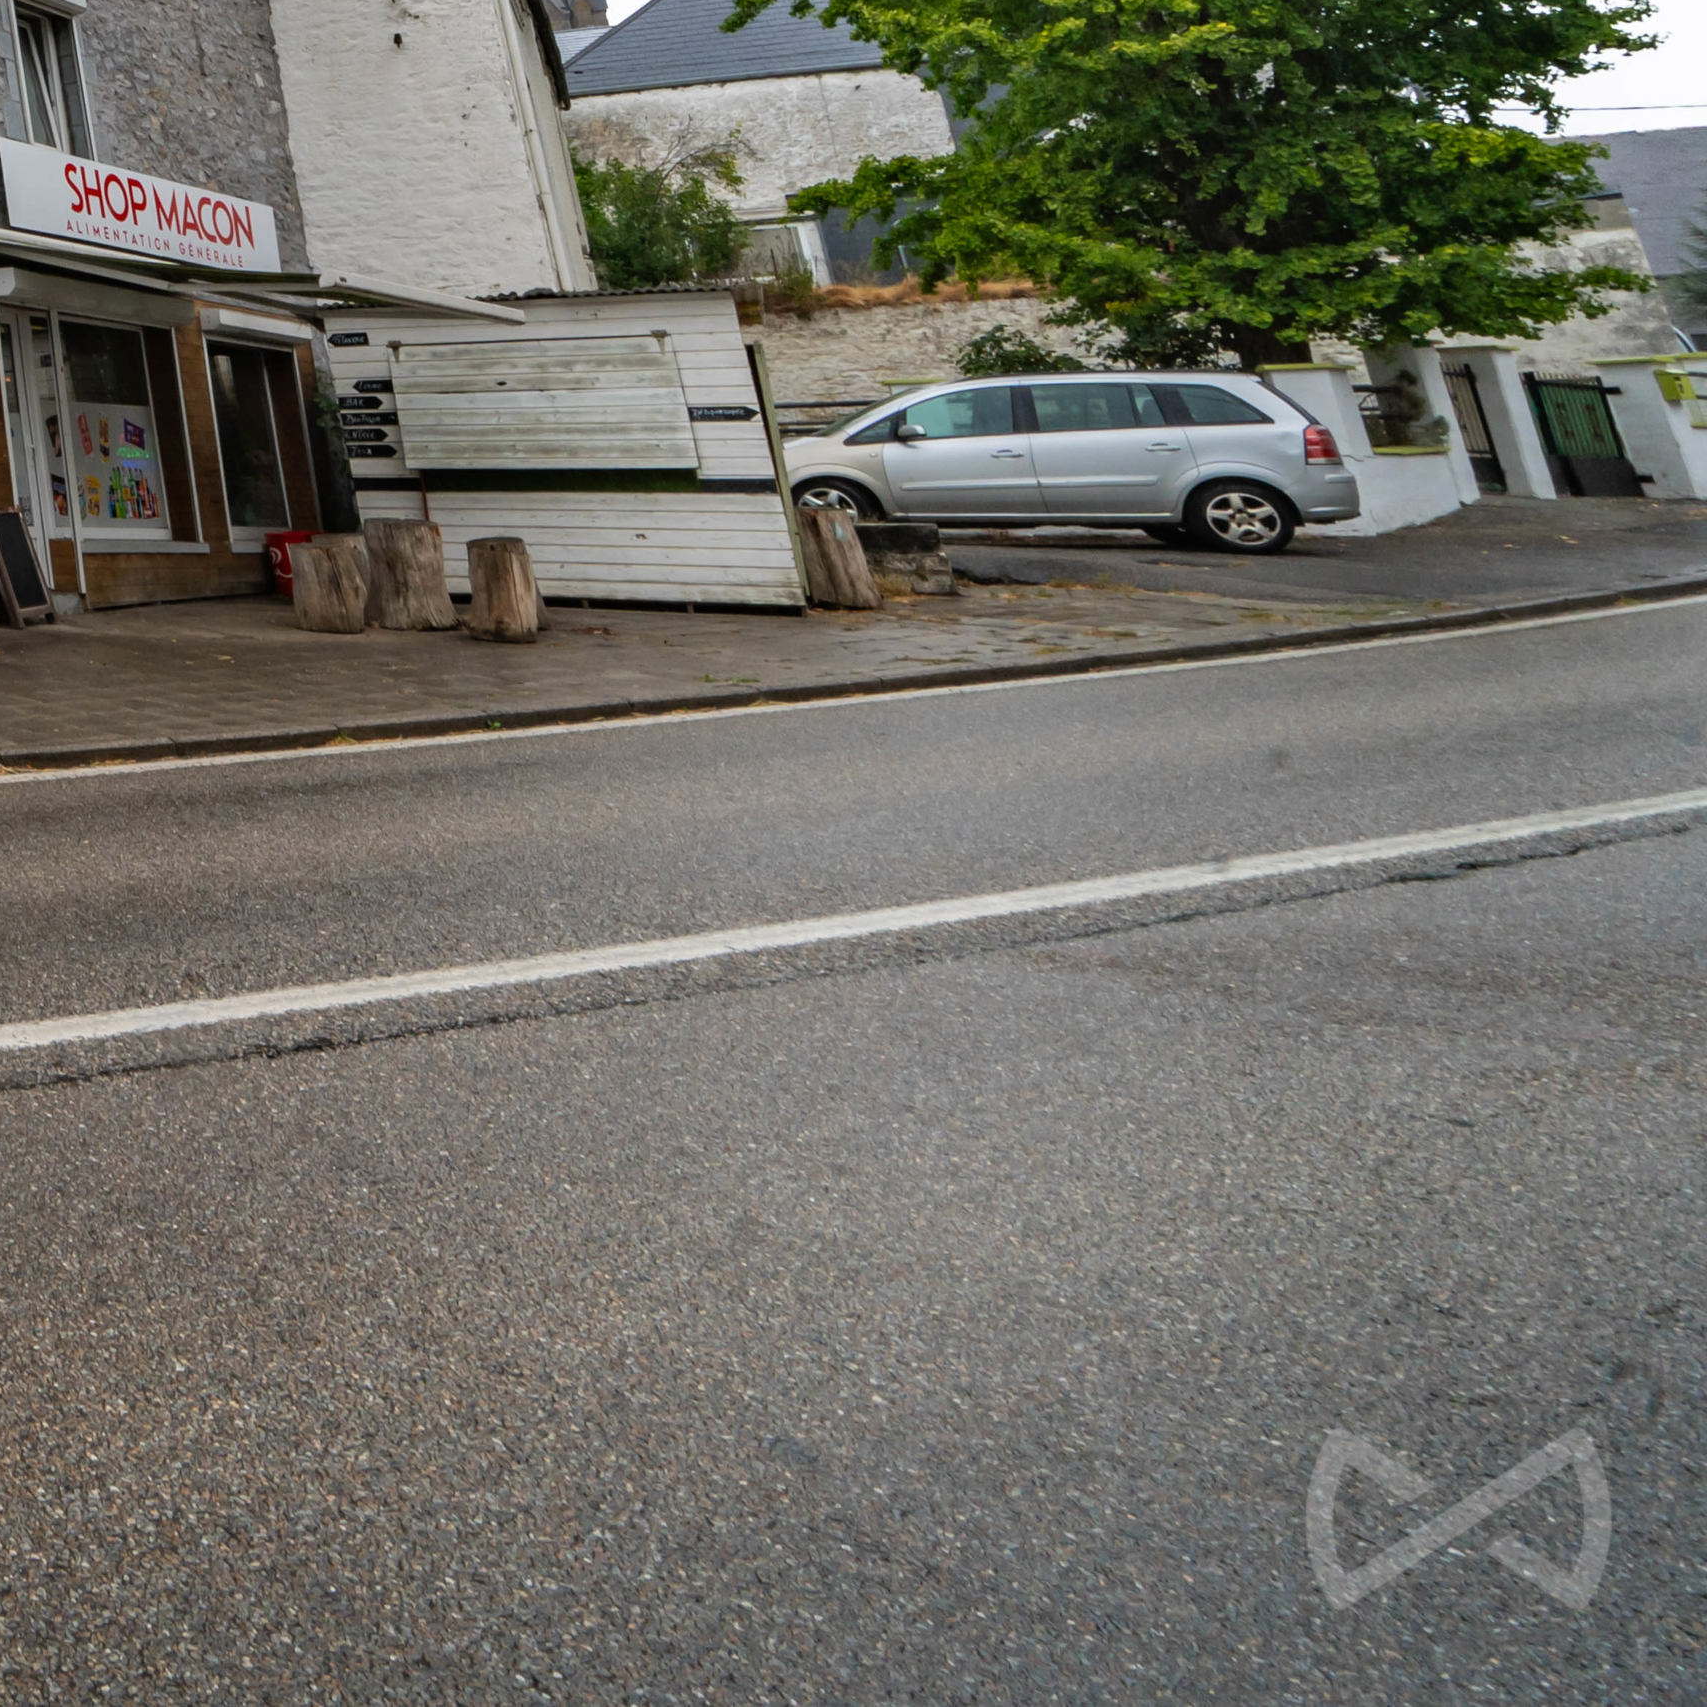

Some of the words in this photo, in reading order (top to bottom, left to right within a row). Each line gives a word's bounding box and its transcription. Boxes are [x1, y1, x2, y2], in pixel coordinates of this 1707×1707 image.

[64, 162, 147, 226] SHOP
[151, 181, 256, 251] MACON
[66, 219, 171, 251] ALIMENTATION
